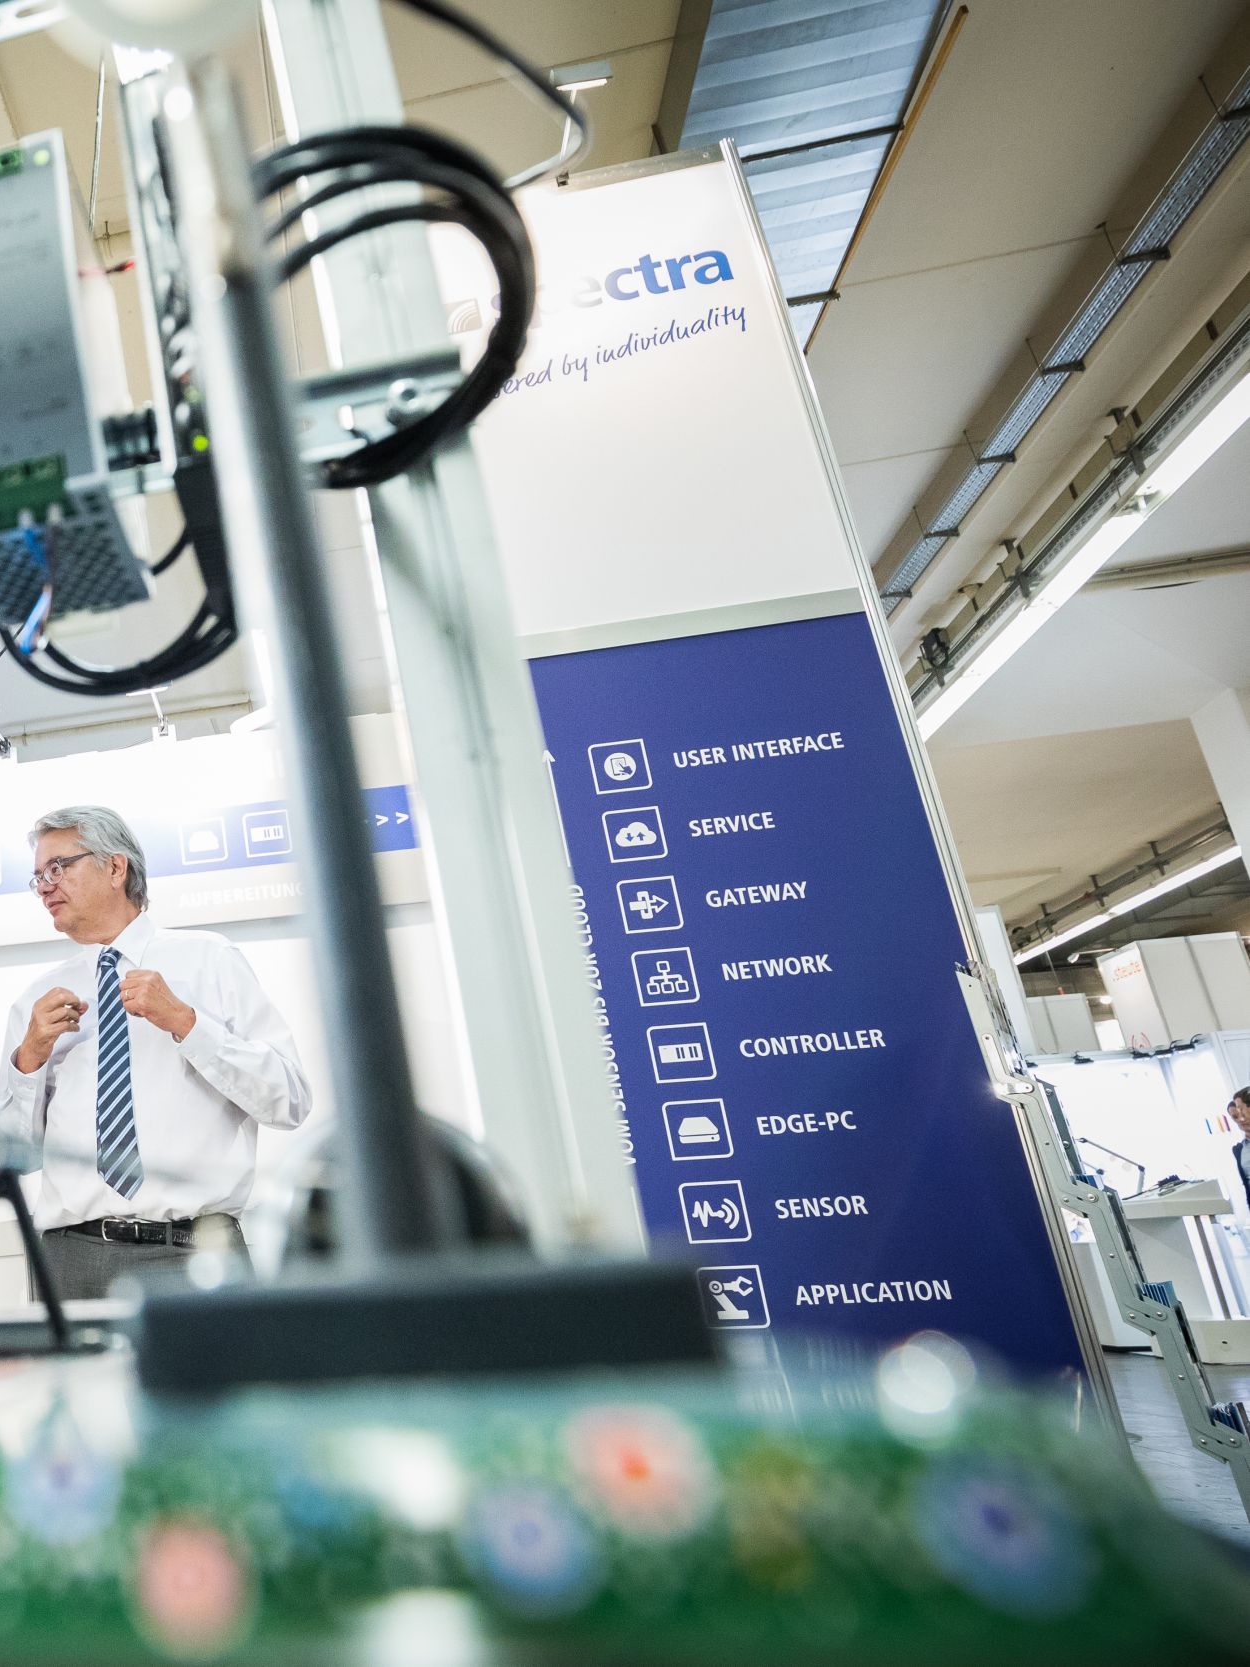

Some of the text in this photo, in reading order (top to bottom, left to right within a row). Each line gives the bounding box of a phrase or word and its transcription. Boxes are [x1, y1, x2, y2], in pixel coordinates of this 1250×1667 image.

[490, 249, 734, 328] ectra
[494, 305, 747, 399] ered by individuality
[673, 732, 844, 767] USER INTERFACE
[689, 812, 775, 836] SERVICE
[706, 881, 806, 907] GATEWAY
[568, 884, 593, 947] CLOUD
[722, 955, 832, 980] NETWORK
[740, 1030, 886, 1057] CONTROLLER
[757, 1111, 856, 1135] EDGE-PC
[775, 1196, 868, 1218] SENSOR
[797, 1280, 951, 1305] APPLICATION
